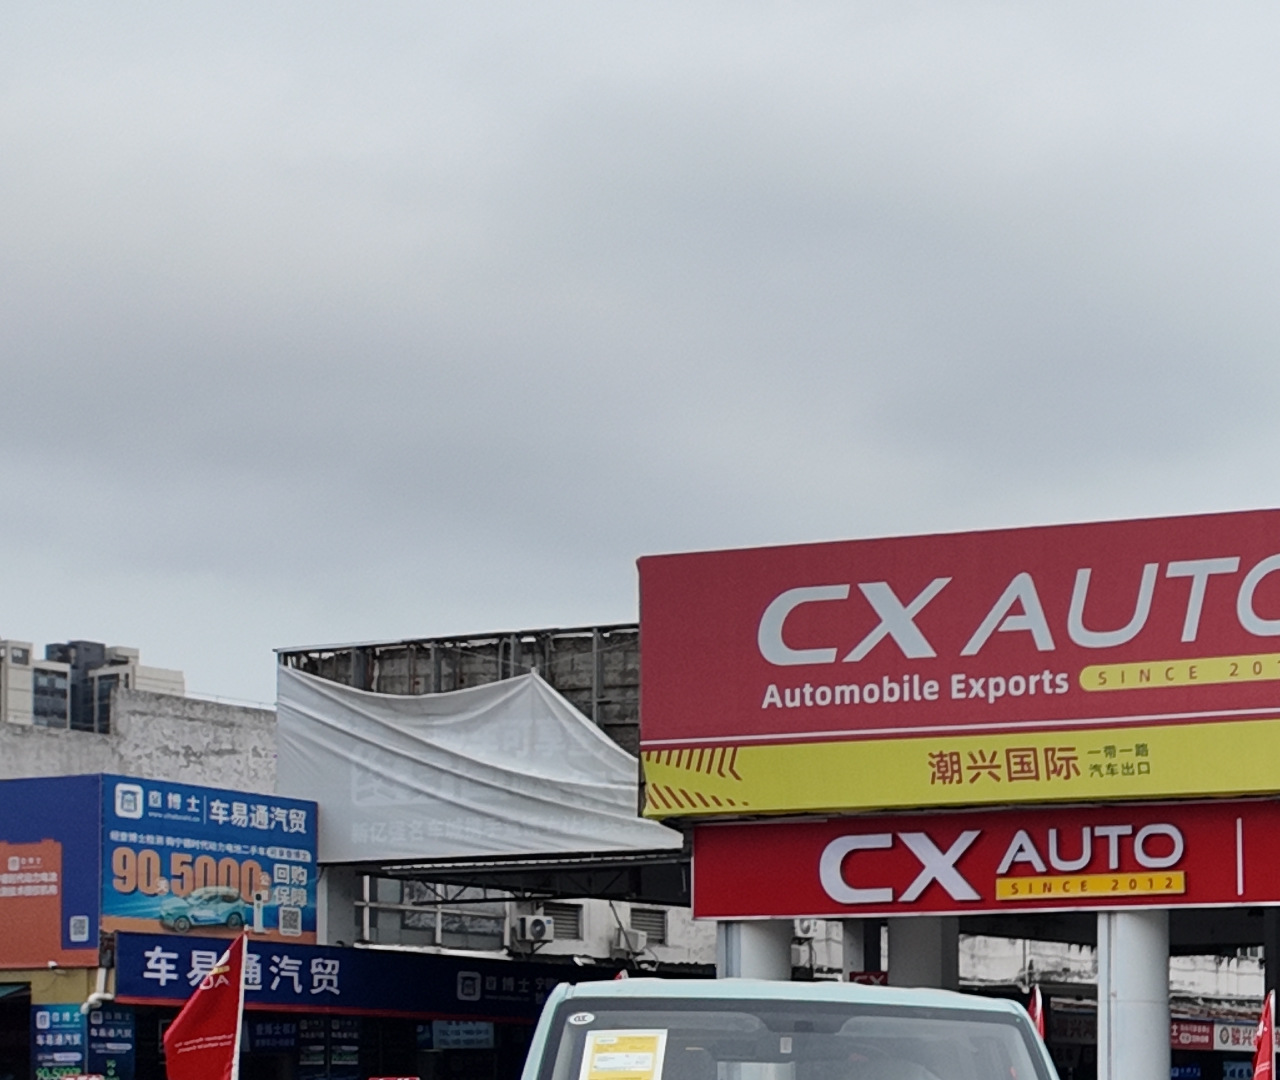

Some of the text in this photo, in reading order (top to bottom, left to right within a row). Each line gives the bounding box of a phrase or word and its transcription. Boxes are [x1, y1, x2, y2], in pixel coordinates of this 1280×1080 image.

[758, 577, 952, 666] CX
[761, 668, 1069, 709] Automobile Exports
[1097, 665, 1199, 686] SINCE
[927, 746, 1081, 786] 潮兴国际
[1087, 742, 1149, 760] 一带一路
[1088, 760, 1151, 778] 汽车出口
[209, 799, 307, 835] 车易通汽贸
[819, 823, 1184, 904] CX AUTO
[1010, 876, 1176, 895] SINCE 2012
